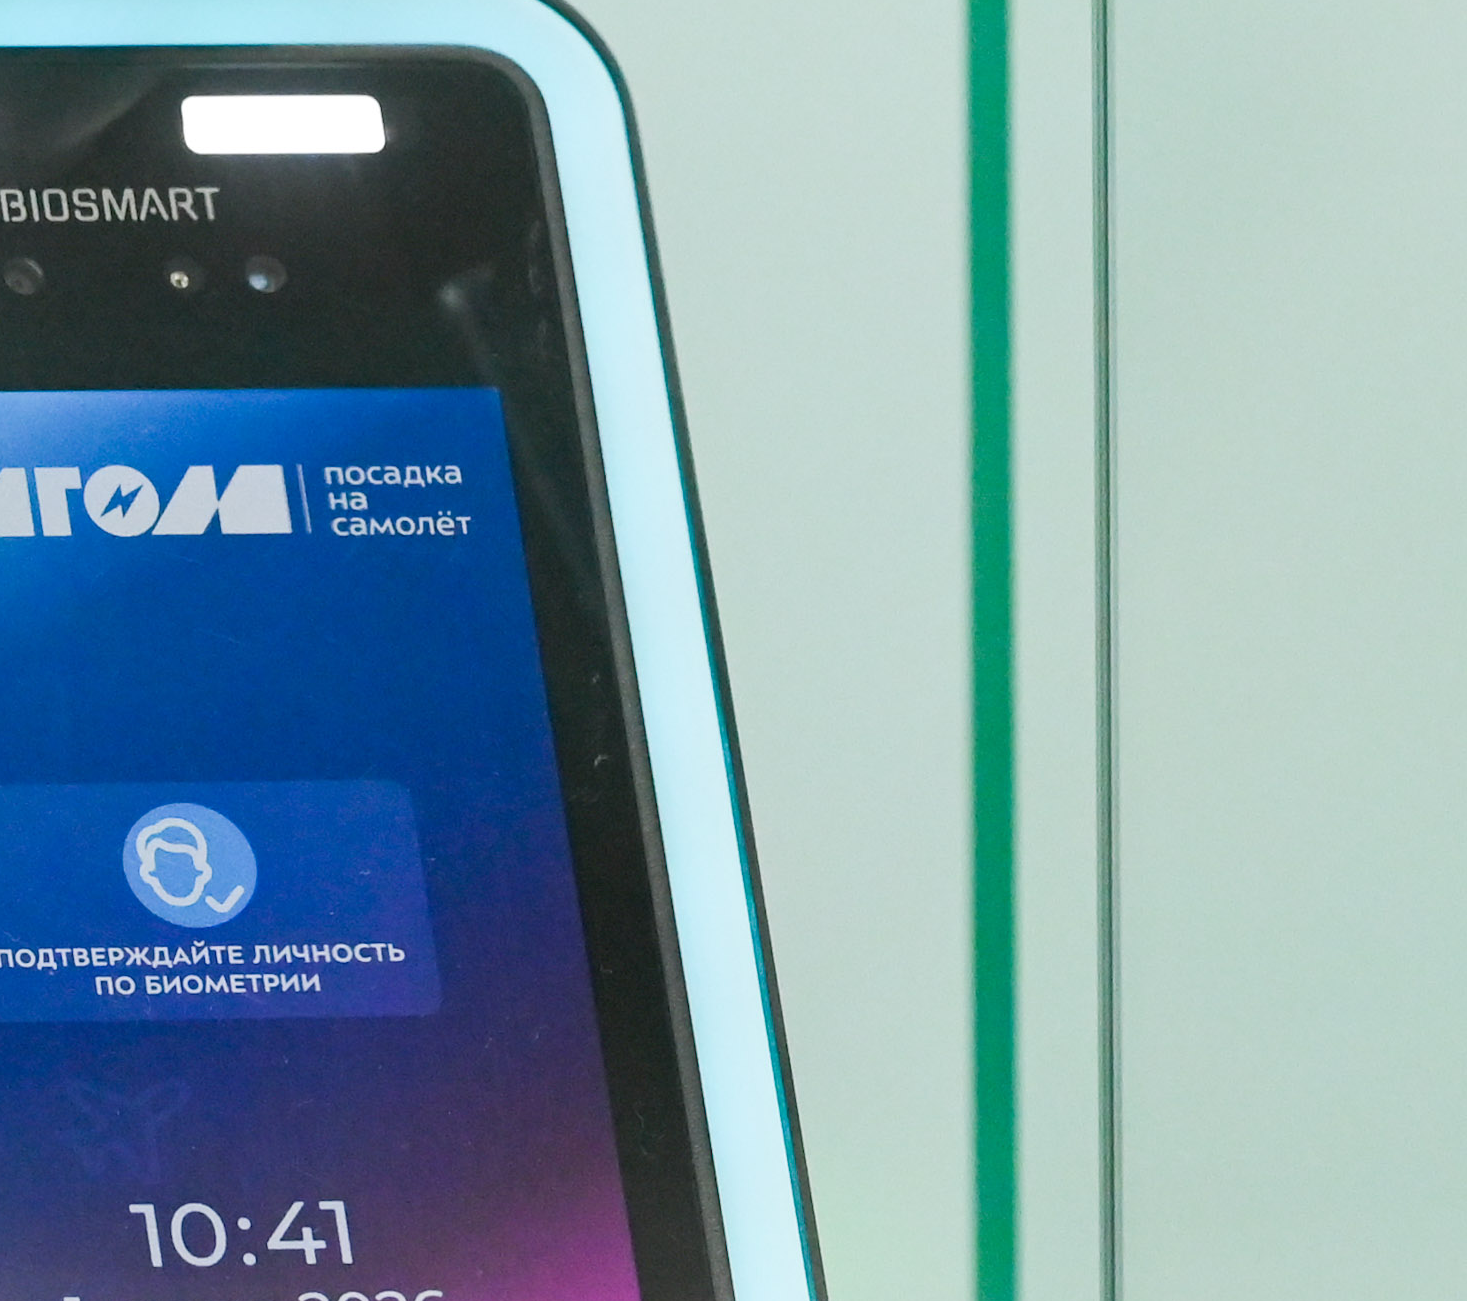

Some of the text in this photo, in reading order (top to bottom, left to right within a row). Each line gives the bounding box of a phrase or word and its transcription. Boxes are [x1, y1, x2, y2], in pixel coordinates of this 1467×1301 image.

[0, 186, 221, 223] BIOSMART
[323, 465, 463, 489] посадка
[328, 491, 369, 510] на
[331, 510, 472, 536] самолёт
[252, 942, 407, 966] ЛИЧНОСТЬ
[94, 972, 323, 996] ПО БИОМЕТРИИ
[128, 1199, 355, 1268] 10:41
